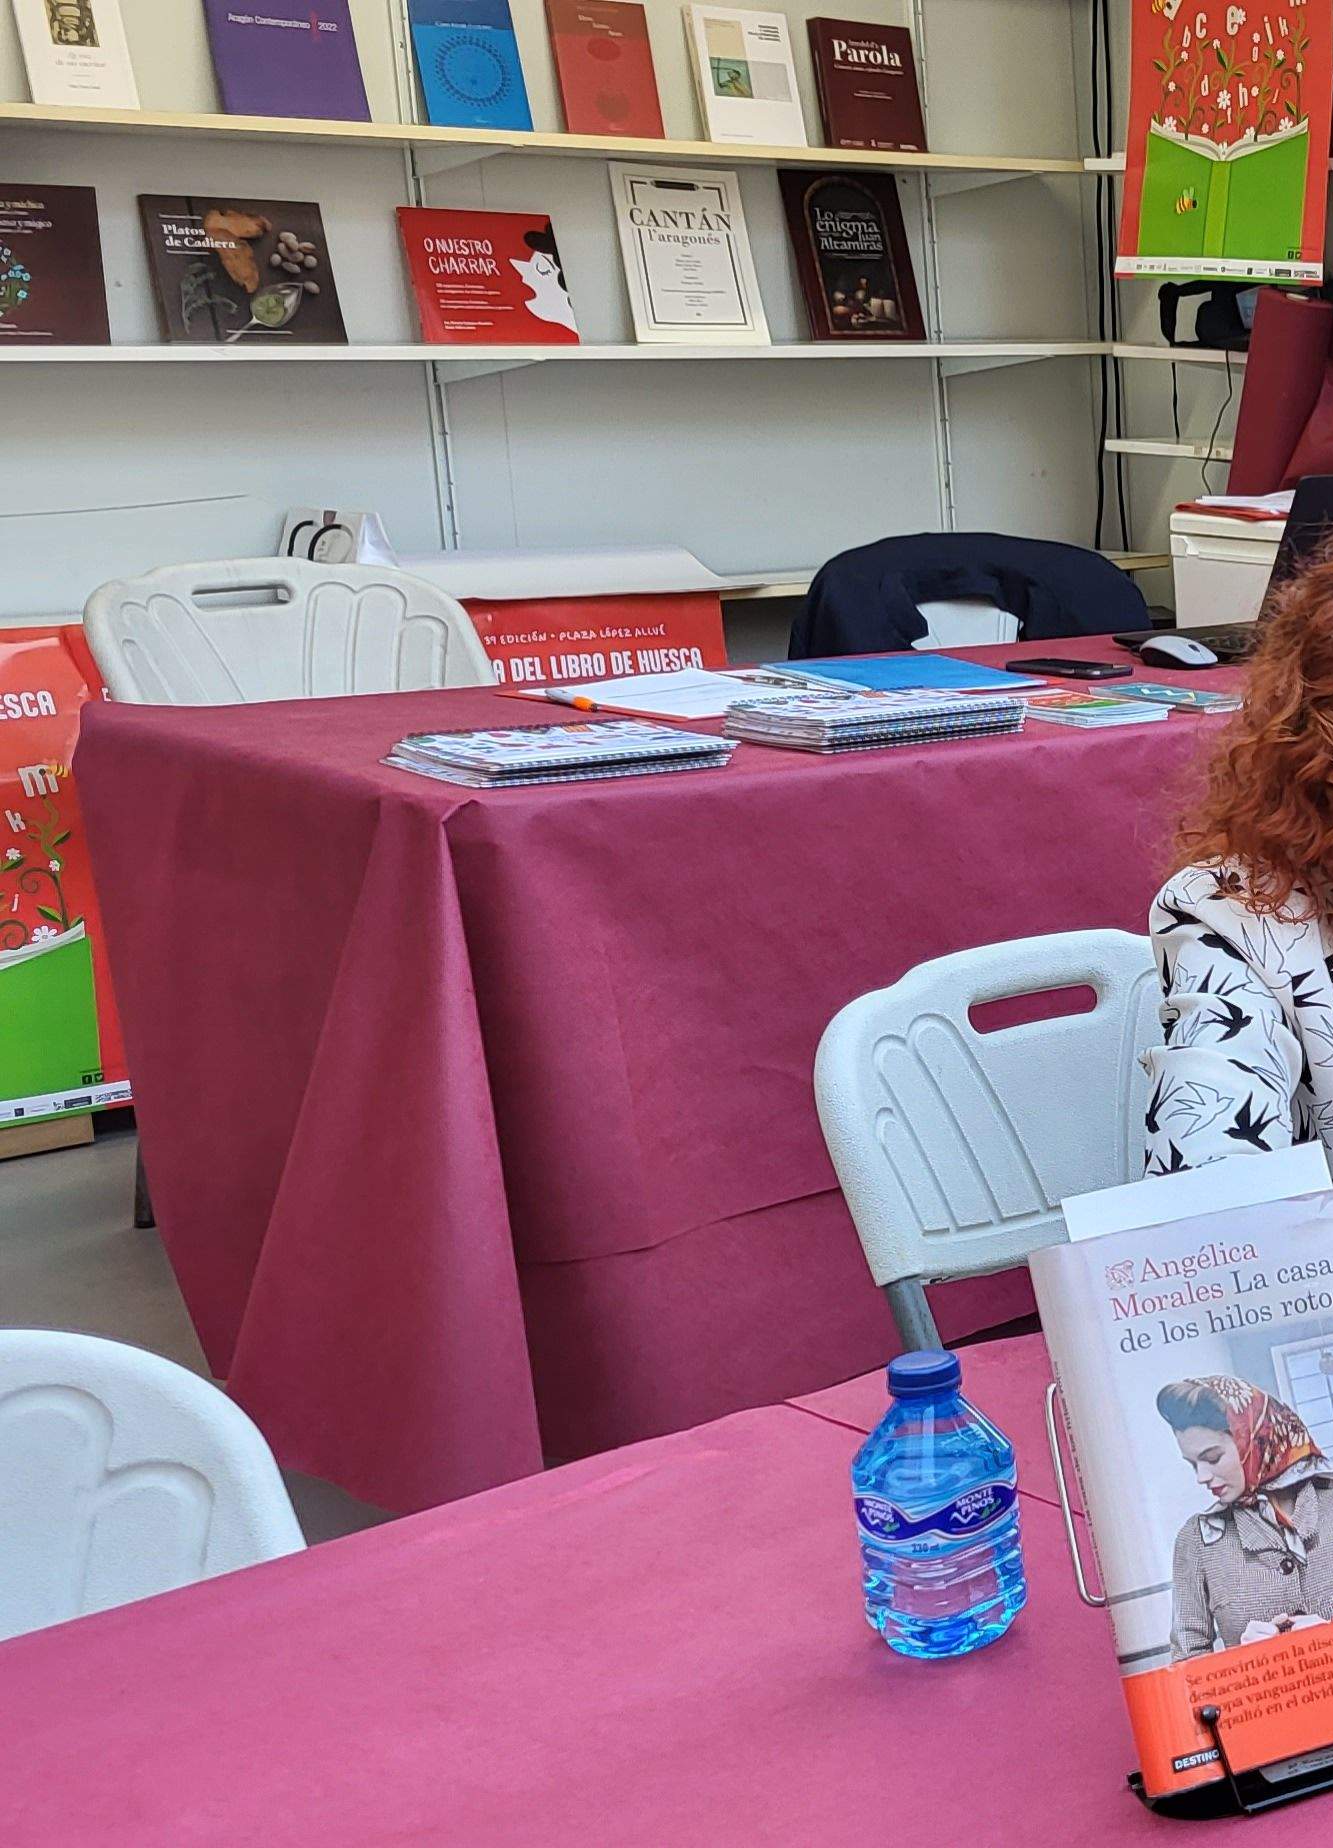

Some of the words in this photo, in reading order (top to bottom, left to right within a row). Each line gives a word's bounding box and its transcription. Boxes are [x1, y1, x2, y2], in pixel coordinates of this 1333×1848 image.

[832, 39, 902, 67] Parola
[162, 224, 206, 236] Platos
[629, 207, 732, 232] CANTÁN
[815, 219, 880, 238] enigma
[165, 237, 181, 247] de
[184, 237, 236, 249] Cadiera
[424, 237, 433, 253] O
[435, 238, 493, 255] NUESTRO
[648, 228, 721, 247] l'aragonés
[820, 237, 883, 250] Altamiras
[428, 257, 500, 276] CHARRAR
[500, 630, 547, 645] EDICIÓN
[559, 629, 597, 641] PLAZA
[600, 626, 632, 639] LÓPEZ
[510, 656, 546, 683] DEL
[550, 652, 606, 679] LIBRO
[609, 650, 634, 676] DE
[637, 647, 704, 675] HUESCA
[1140, 1241, 1259, 1284] Angélica
[1109, 1281, 1225, 1321] Morales
[1230, 1270, 1269, 1295] La
[1277, 1259, 1333, 1285] casa
[1120, 1328, 1152, 1354] de
[1159, 1320, 1200, 1344] los
[1207, 1304, 1273, 1334] hilos
[956, 1487, 994, 1508] MONTE
[961, 1497, 995, 1516] PINOS
[1206, 1654, 1269, 1682] convirtió
[1272, 1650, 1289, 1663] en
[1291, 1645, 1305, 1657] la
[1189, 1675, 1260, 1704] destacada
[1262, 1669, 1279, 1684] de
[1281, 1665, 1296, 1677] la
[1218, 1709, 1263, 1730] epultó
[1266, 1703, 1283, 1716] en
[1287, 1696, 1299, 1709] el
[1174, 1749, 1220, 1770] DESTINO
